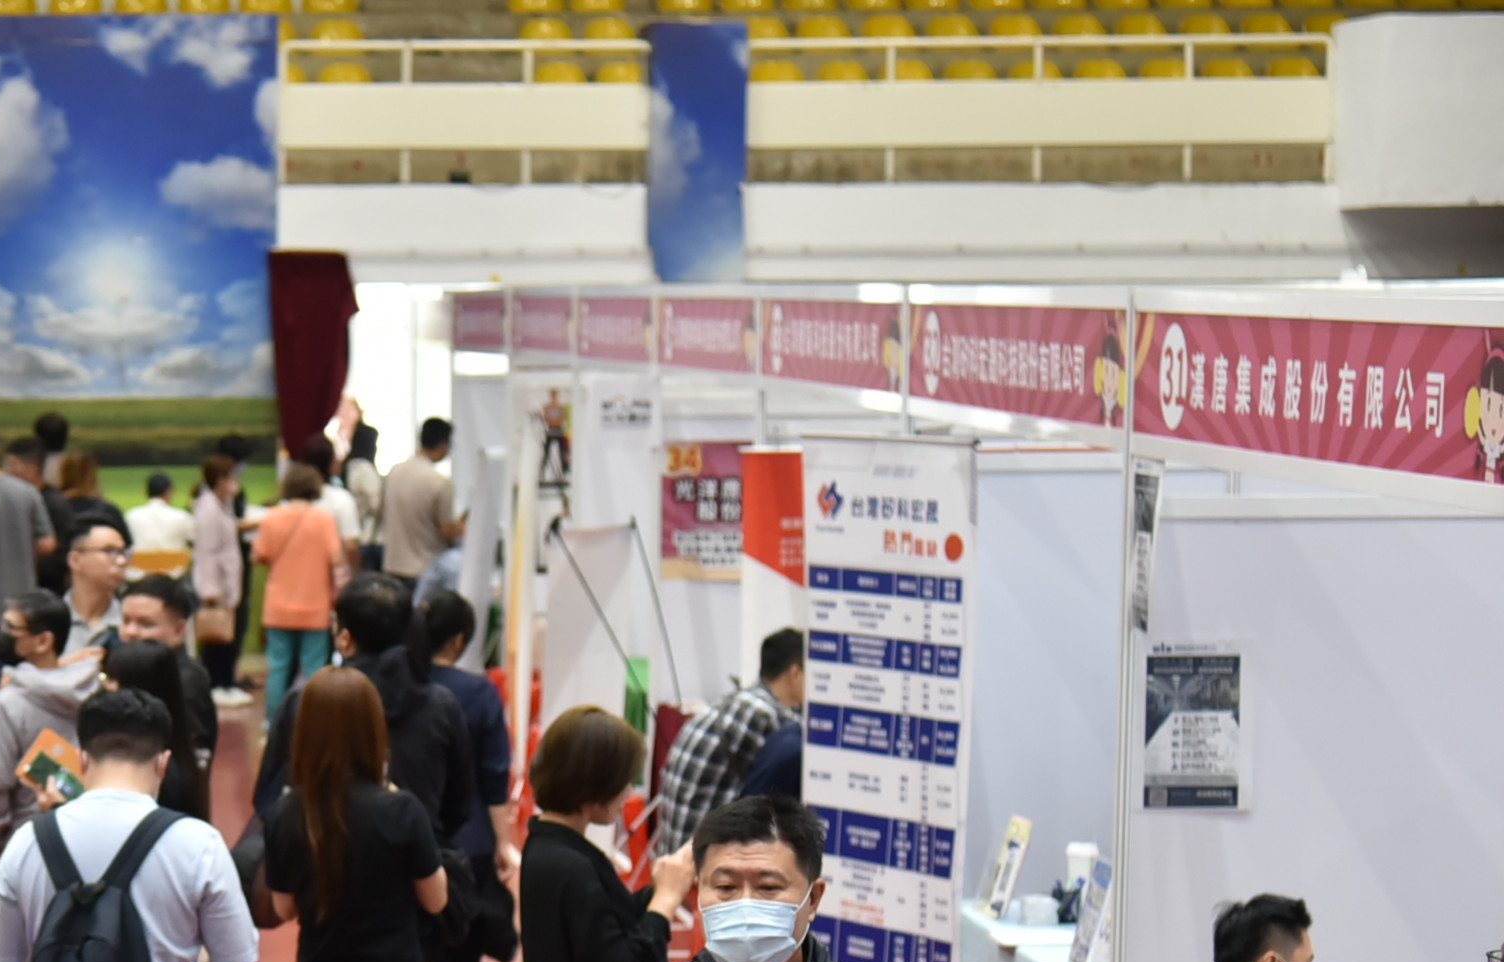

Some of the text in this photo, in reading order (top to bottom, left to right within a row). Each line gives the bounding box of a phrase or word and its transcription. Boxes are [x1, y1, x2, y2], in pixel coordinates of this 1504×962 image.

[1161, 345, 1187, 408] 31
[1189, 352, 1446, 438] 漢唐集成股份有限公司
